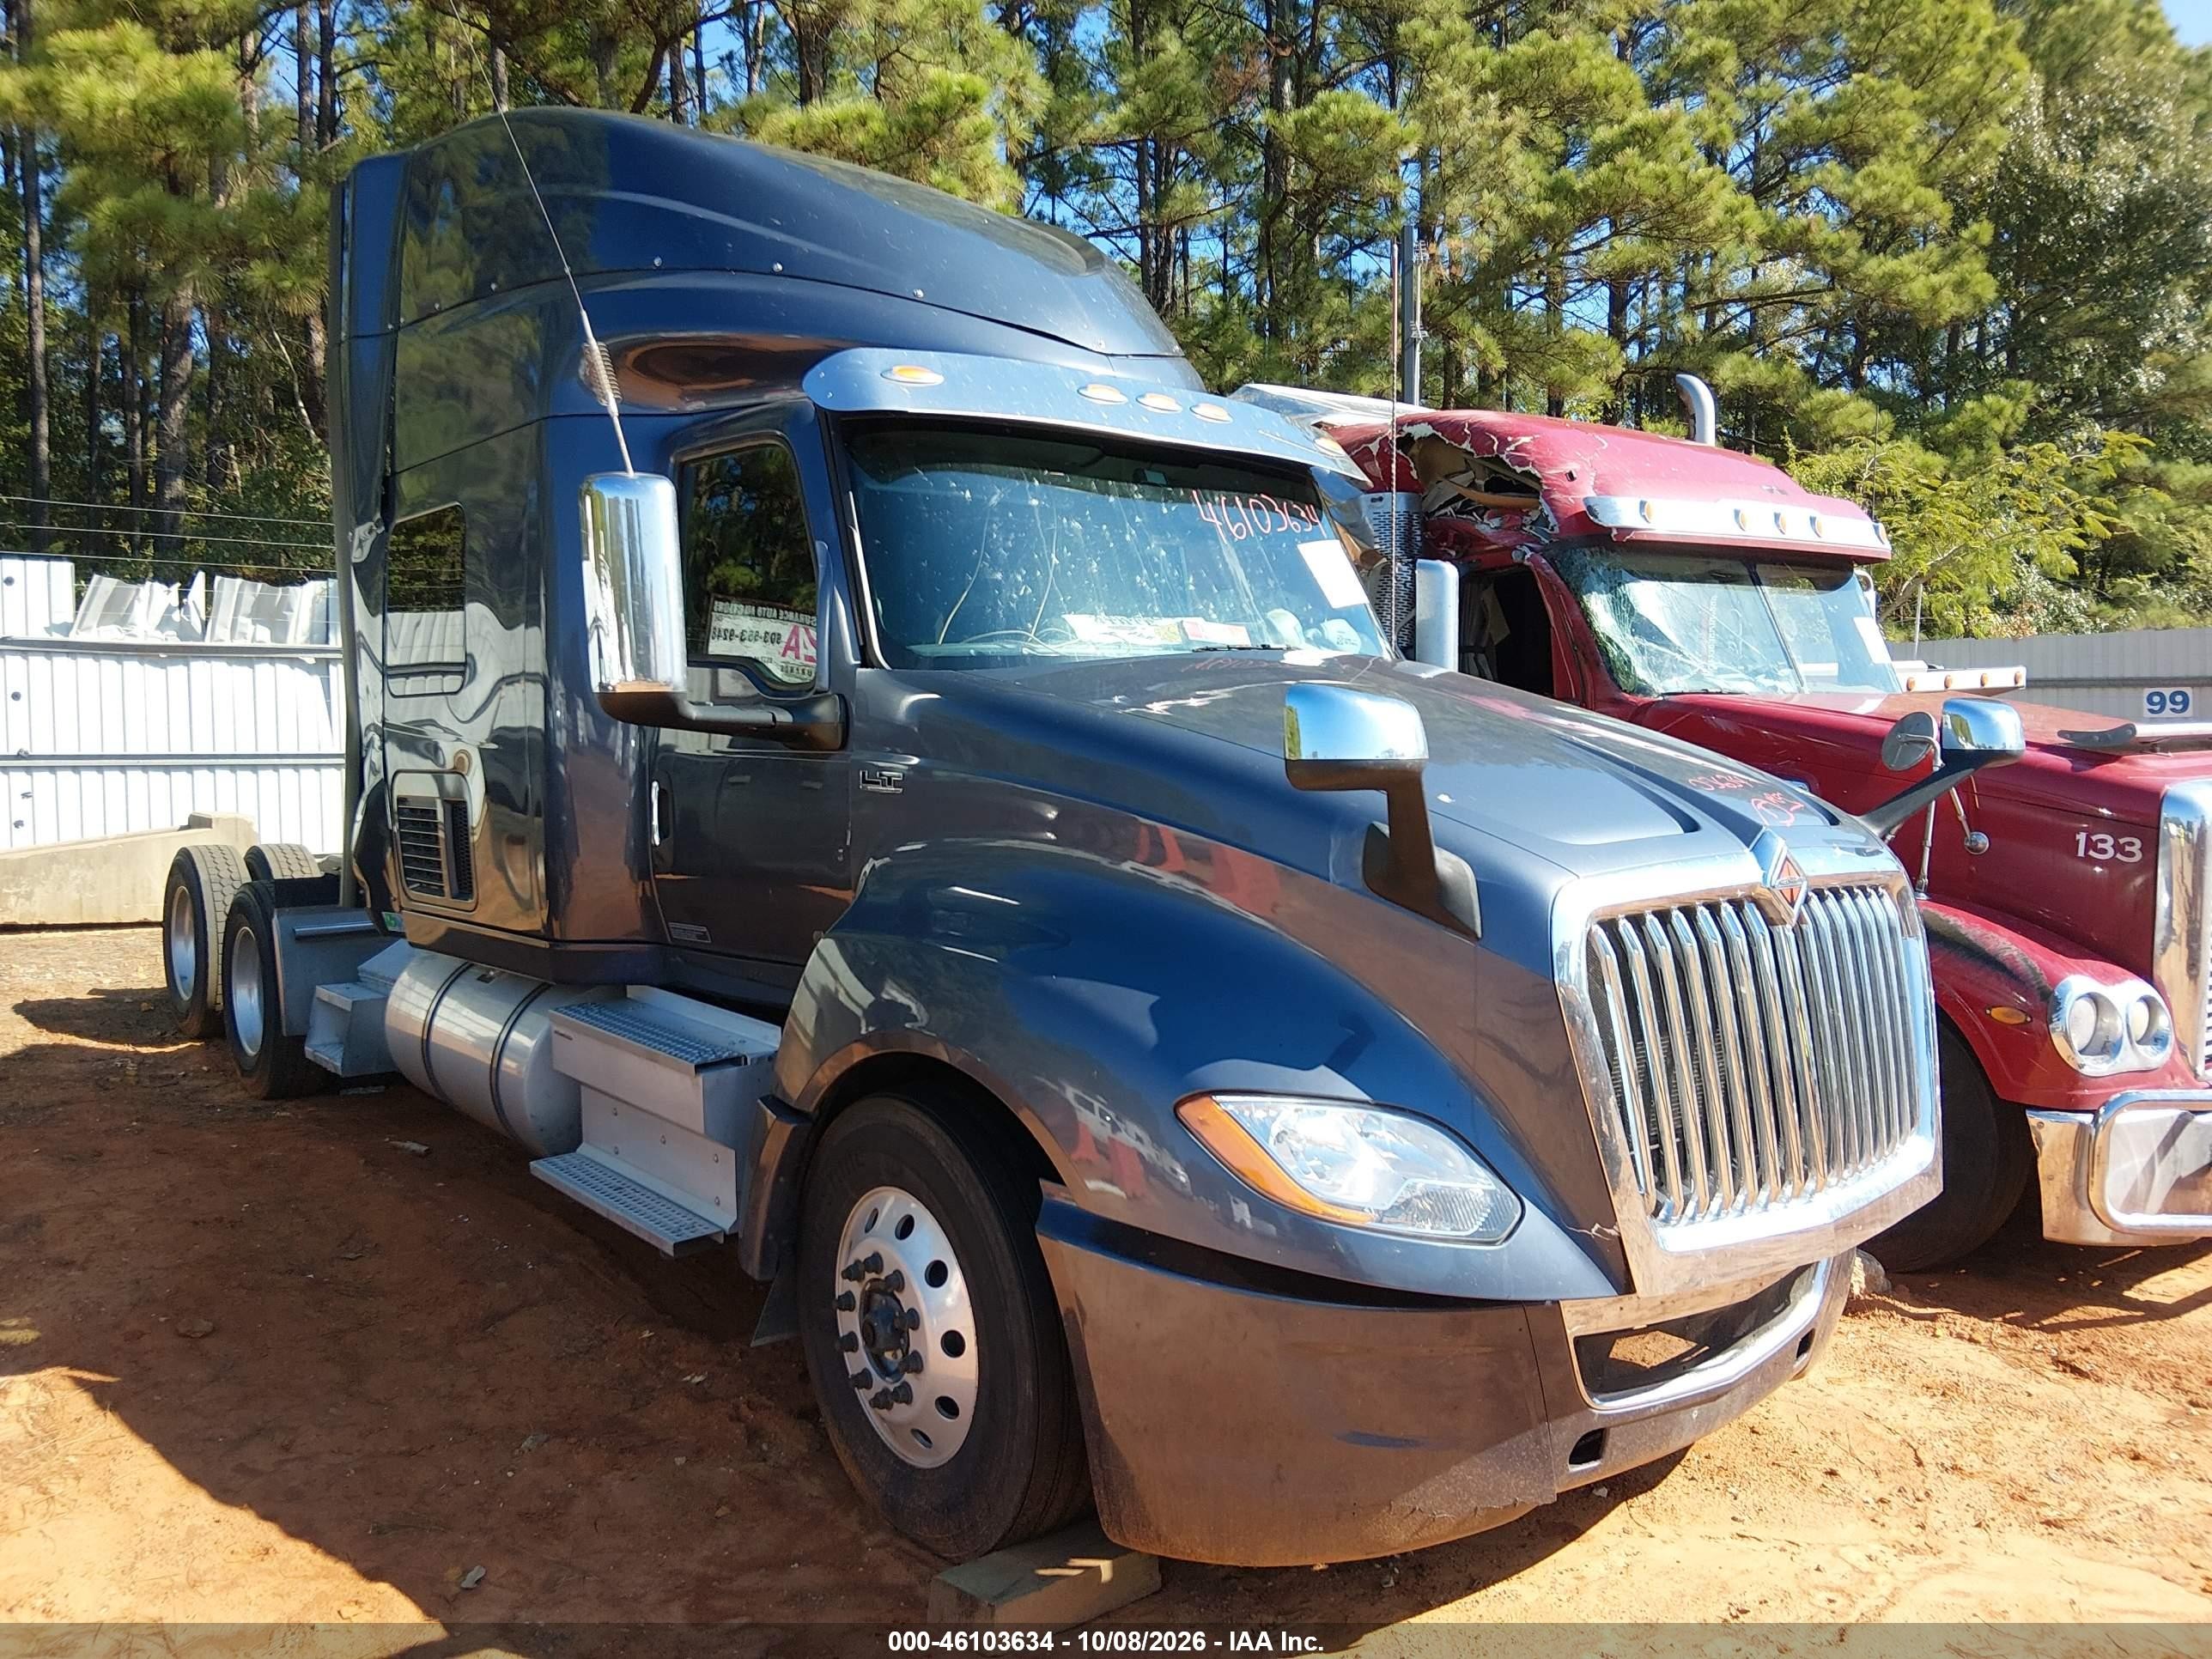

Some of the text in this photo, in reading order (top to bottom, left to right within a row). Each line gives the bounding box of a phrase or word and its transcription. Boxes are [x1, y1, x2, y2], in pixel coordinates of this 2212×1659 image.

[1192, 489, 1328, 544] 46103634
[2146, 690, 2190, 714] 99
[2075, 831, 2143, 863] 133
